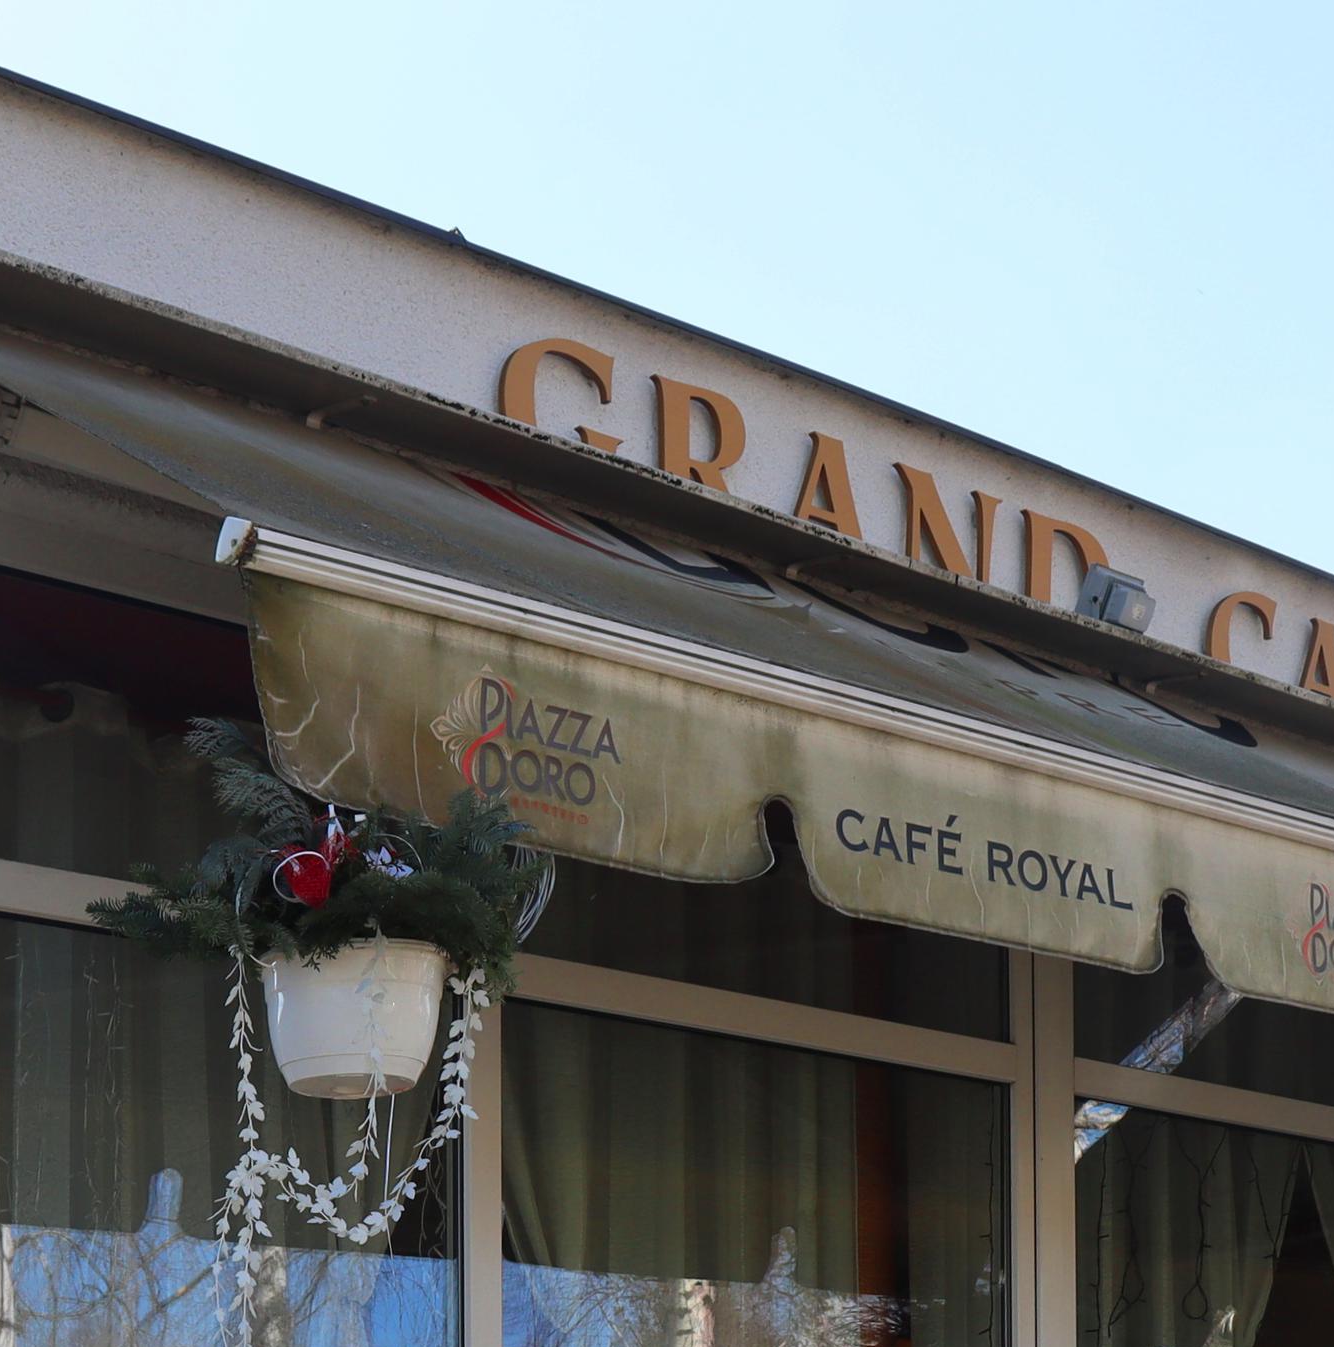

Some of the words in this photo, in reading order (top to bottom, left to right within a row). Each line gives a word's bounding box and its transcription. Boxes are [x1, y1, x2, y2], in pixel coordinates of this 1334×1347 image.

[498, 337, 1110, 605] GRAND
[480, 677, 621, 765] PIAZZA
[835, 808, 964, 876] CAFÉ
[986, 840, 1134, 911] ROYAL
